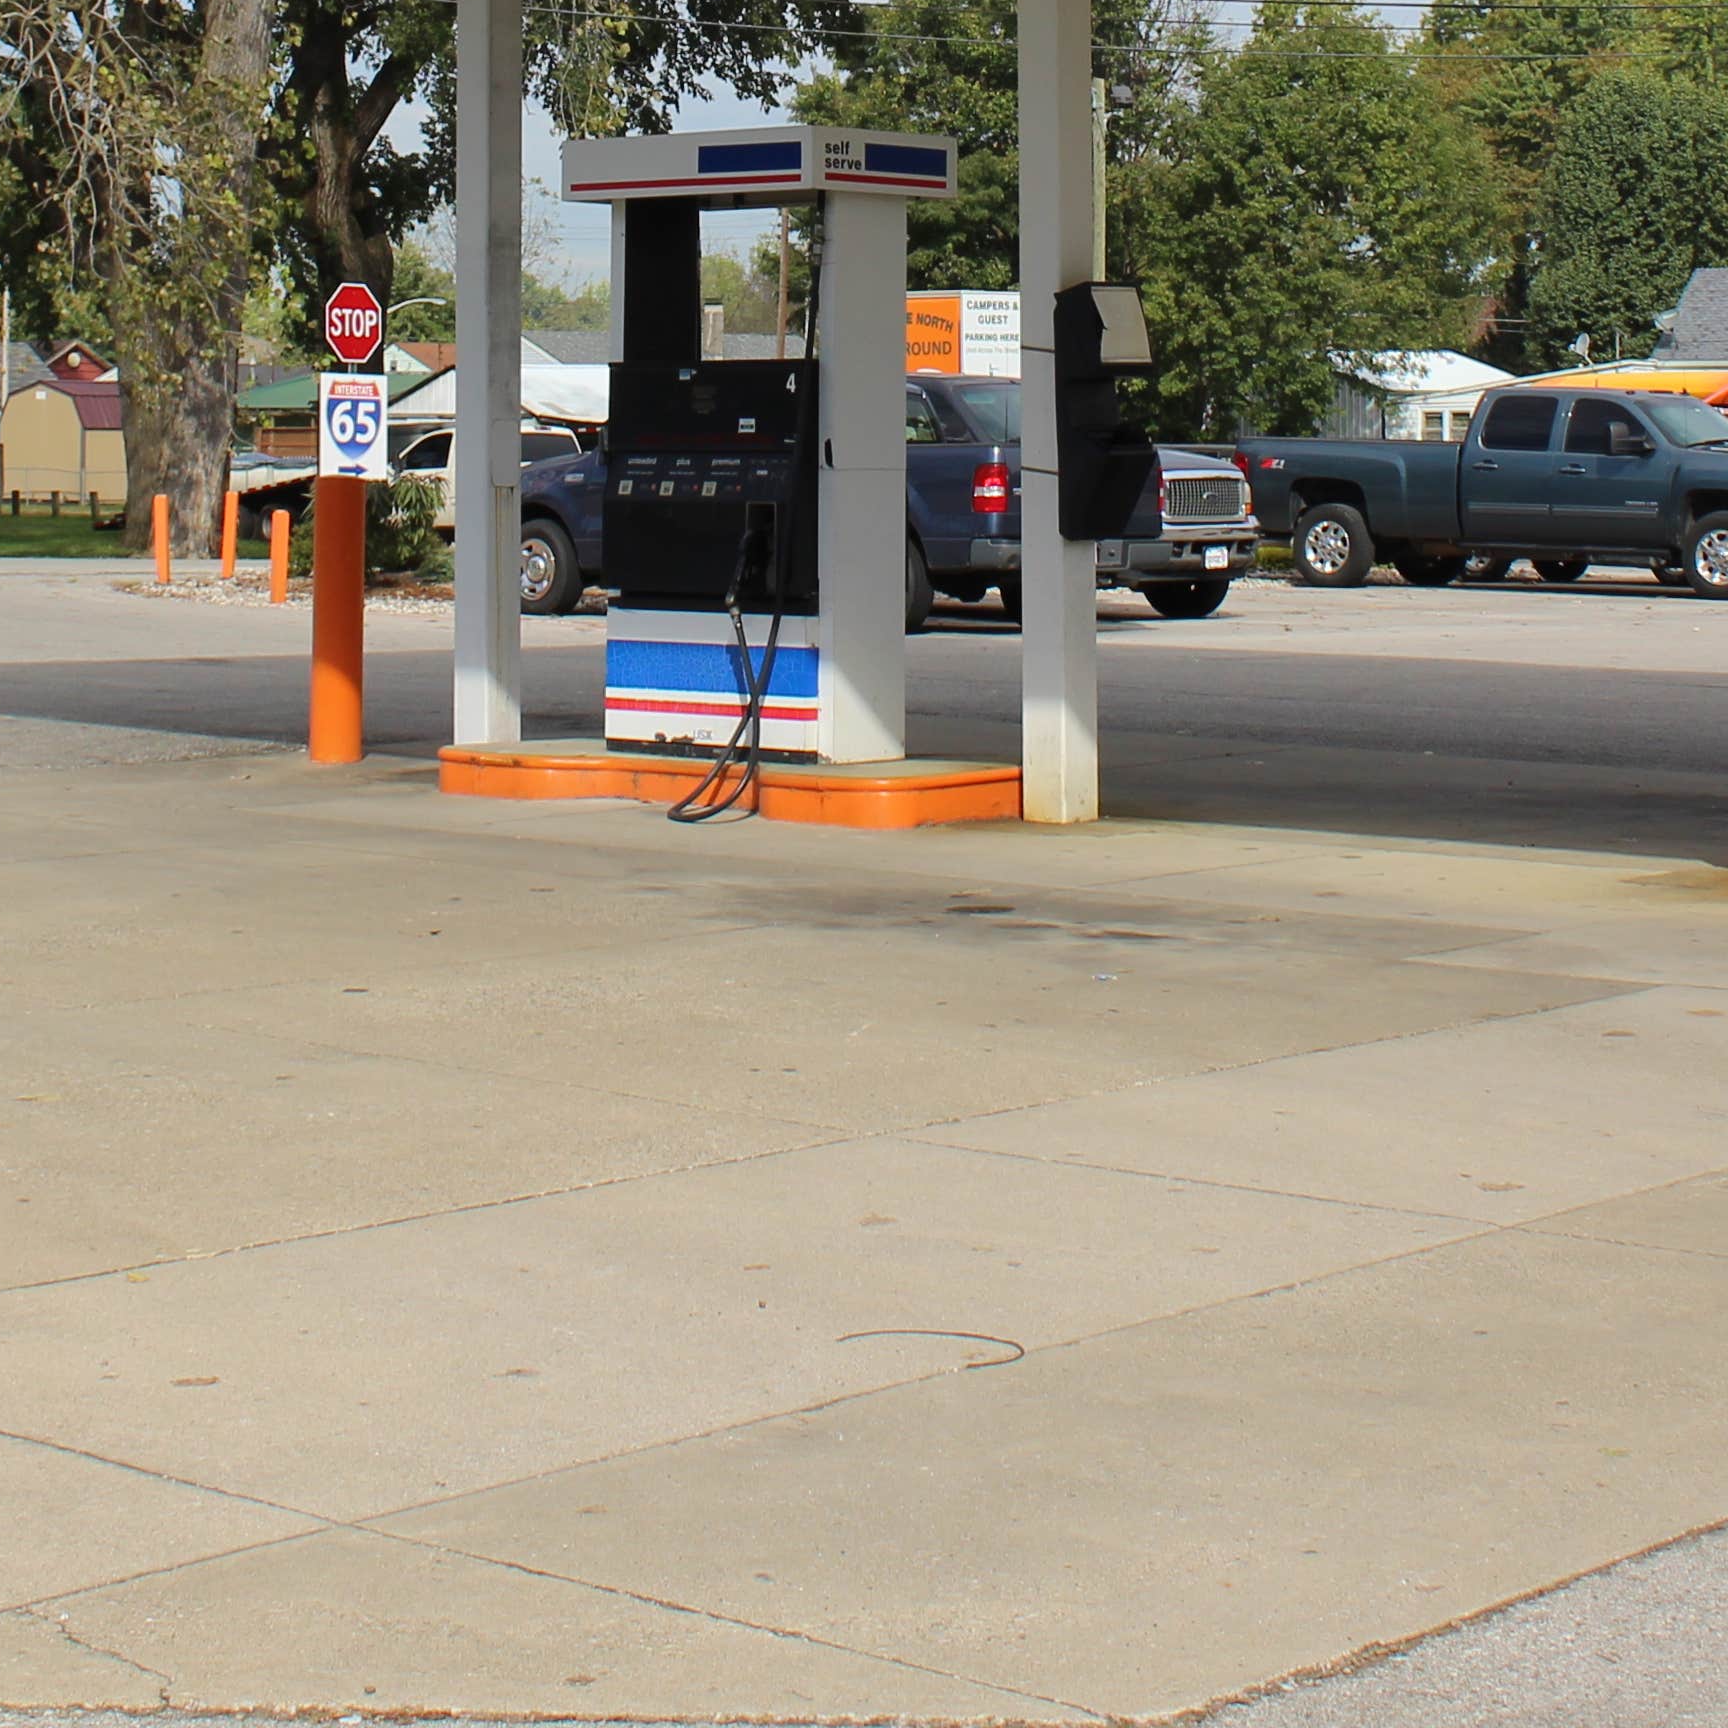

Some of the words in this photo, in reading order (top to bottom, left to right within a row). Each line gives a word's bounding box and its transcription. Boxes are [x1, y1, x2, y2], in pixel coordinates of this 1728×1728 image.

[824, 140, 850, 155] self
[824, 157, 862, 170] serve
[966, 300, 1010, 311] CAMPERS
[330, 307, 377, 338] STOP
[916, 313, 953, 333] NORTH
[978, 314, 1009, 325] GUEST
[965, 332, 998, 342] PARKING
[1000, 333, 1019, 341] HERE
[906, 341, 952, 356] ROUND
[786, 373, 797, 393] 4
[332, 401, 376, 444] 65
